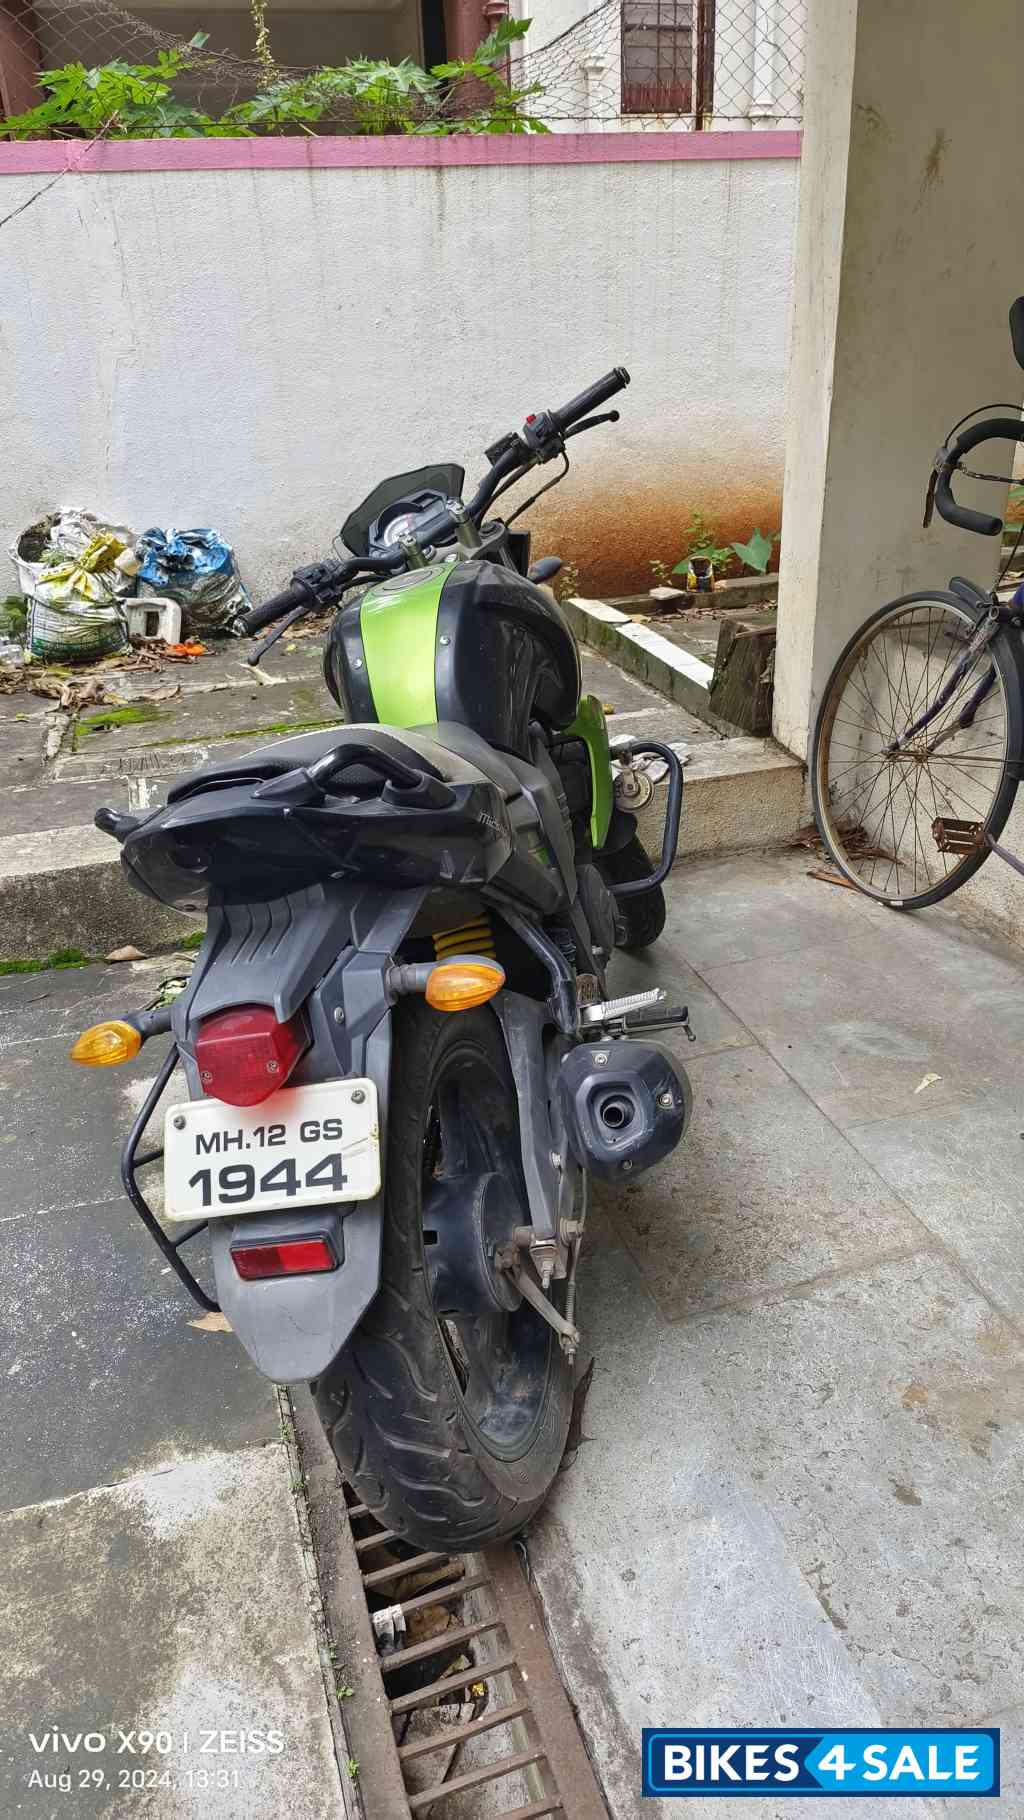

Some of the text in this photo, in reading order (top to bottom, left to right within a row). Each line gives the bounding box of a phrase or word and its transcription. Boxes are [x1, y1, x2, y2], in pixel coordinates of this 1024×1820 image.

[195, 1118, 343, 1155] MH.12 GS
[189, 1153, 348, 1207] 1944
